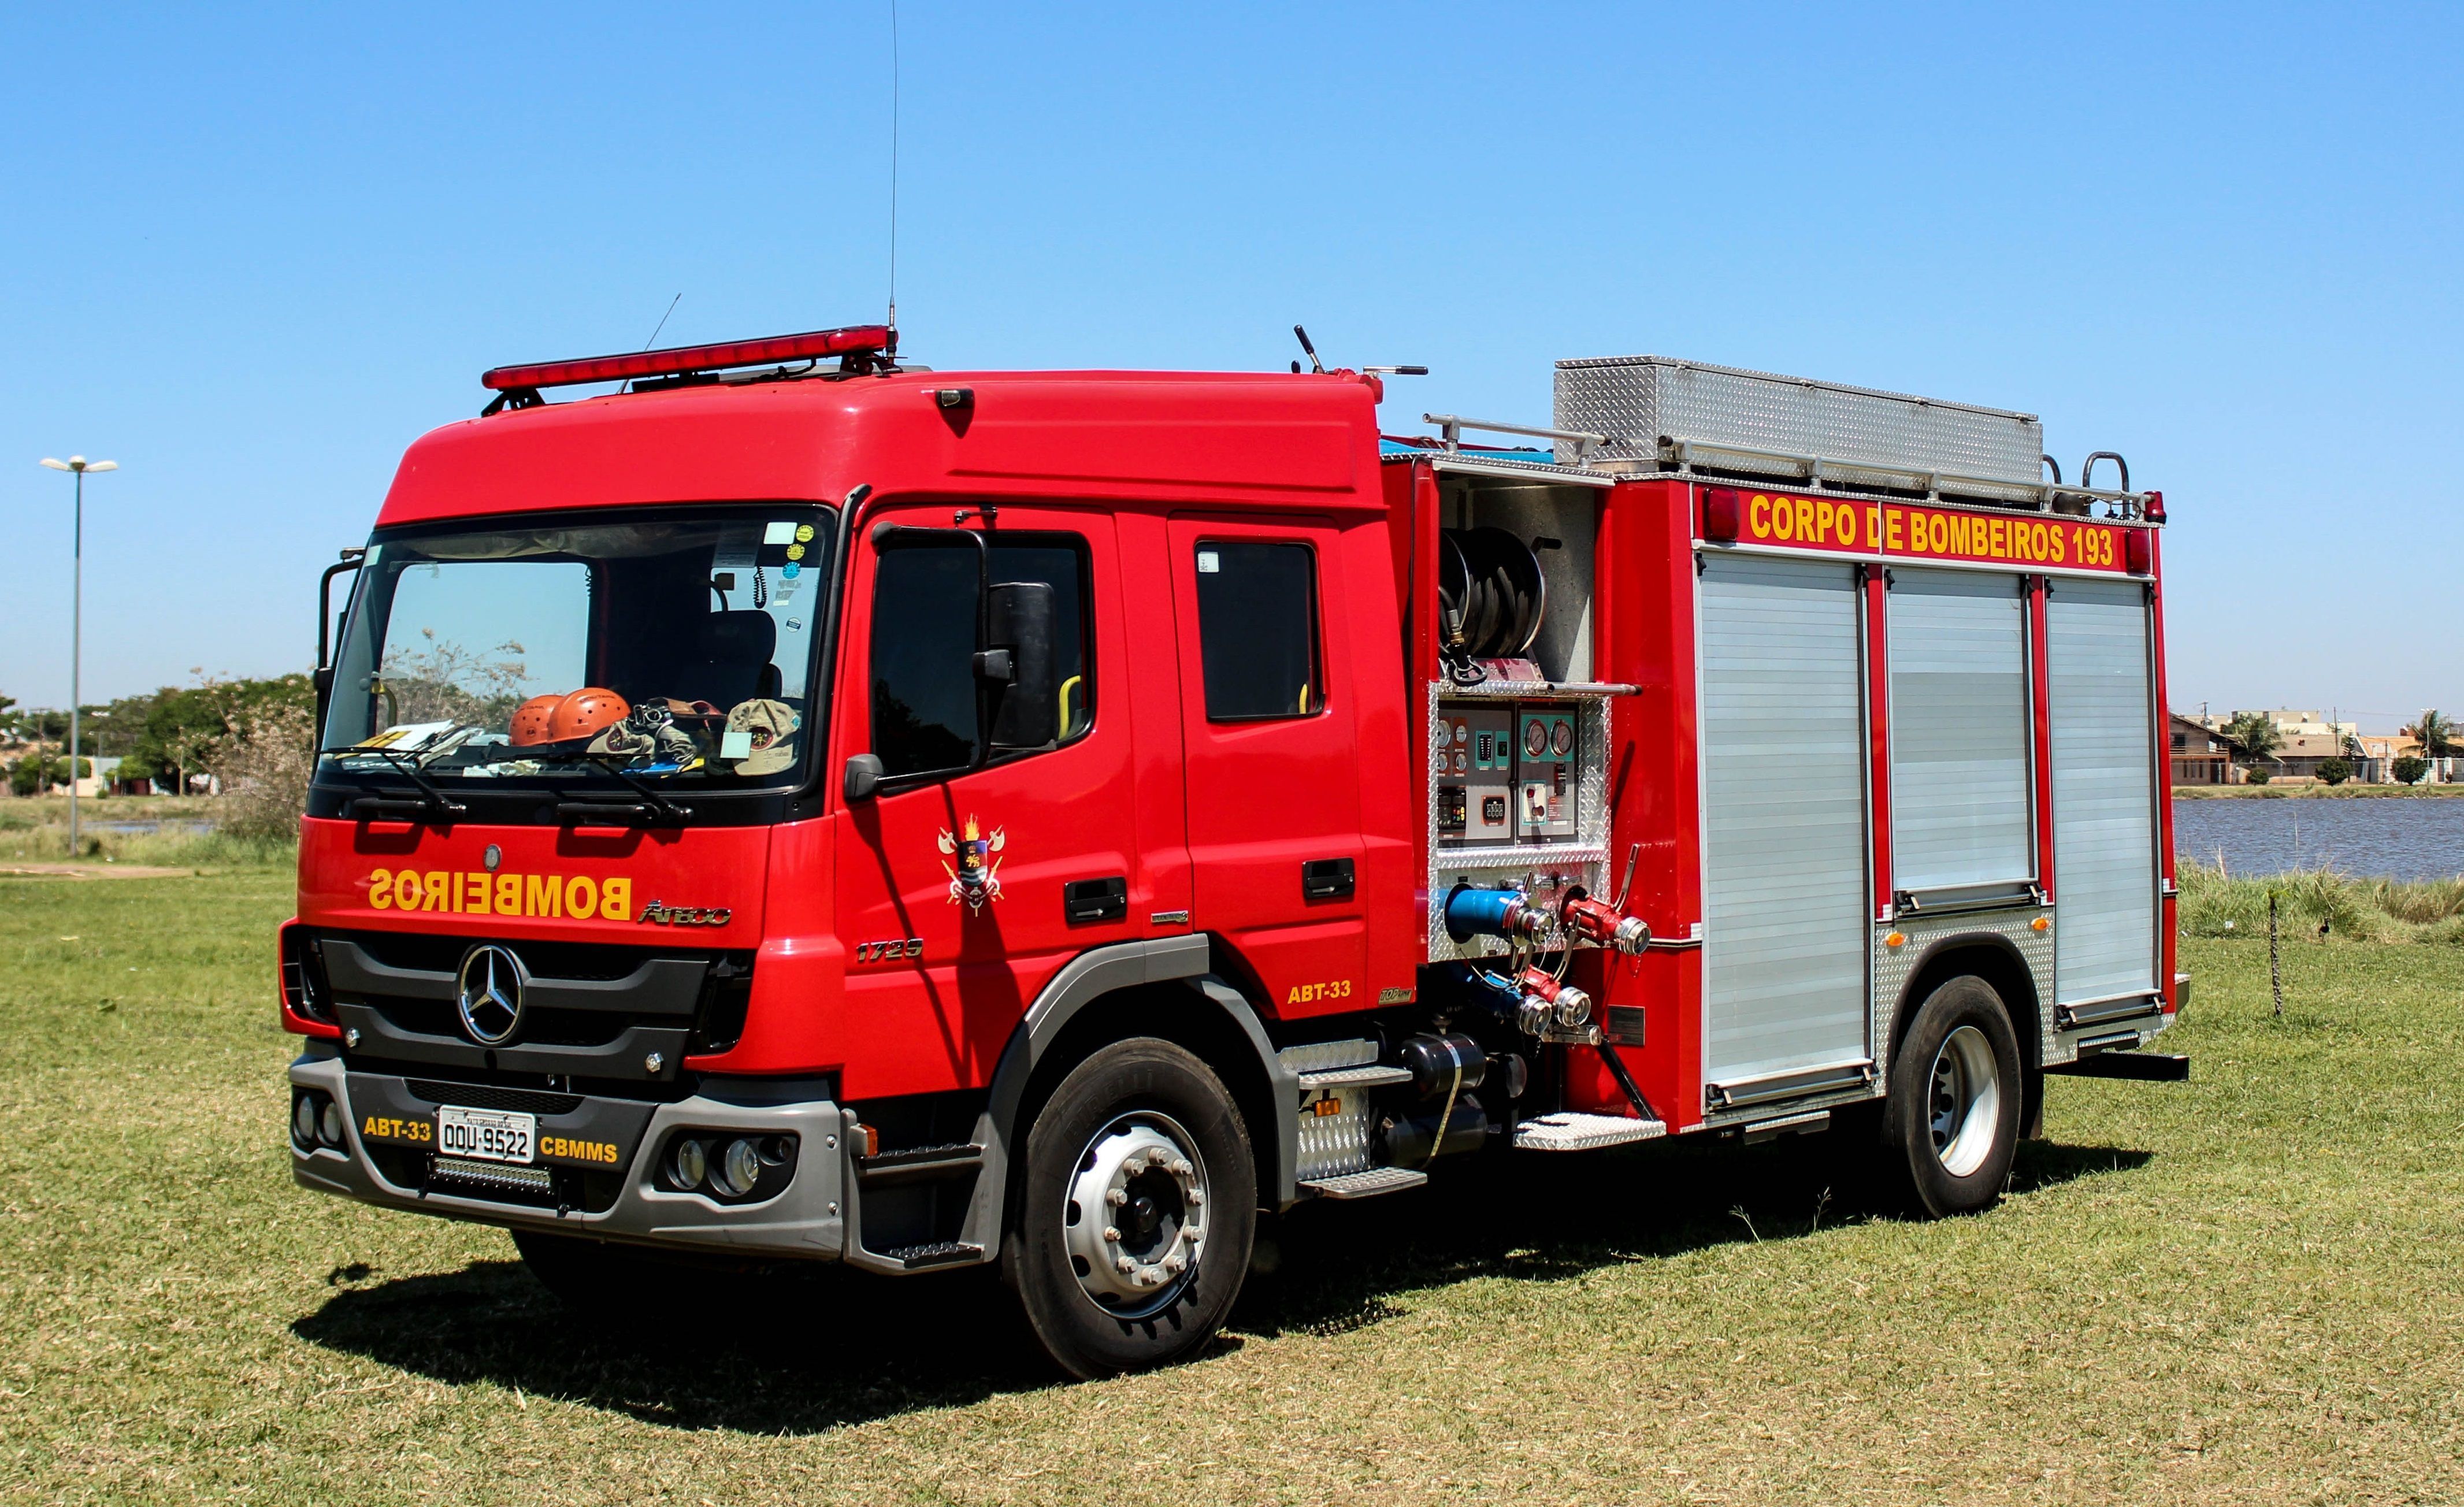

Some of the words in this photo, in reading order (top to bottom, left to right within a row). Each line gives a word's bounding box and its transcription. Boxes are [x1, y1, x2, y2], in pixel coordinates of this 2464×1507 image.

[1750, 495, 1857, 545] CORPO
[1866, 507, 1903, 550] DE
[1910, 512, 2065, 562] BOMBEIROS
[2073, 528, 2113, 566] 193
[1288, 980, 1351, 1004] ABT-33
[364, 1117, 431, 1142] ABT-33
[540, 1137, 618, 1163] CBMMS
